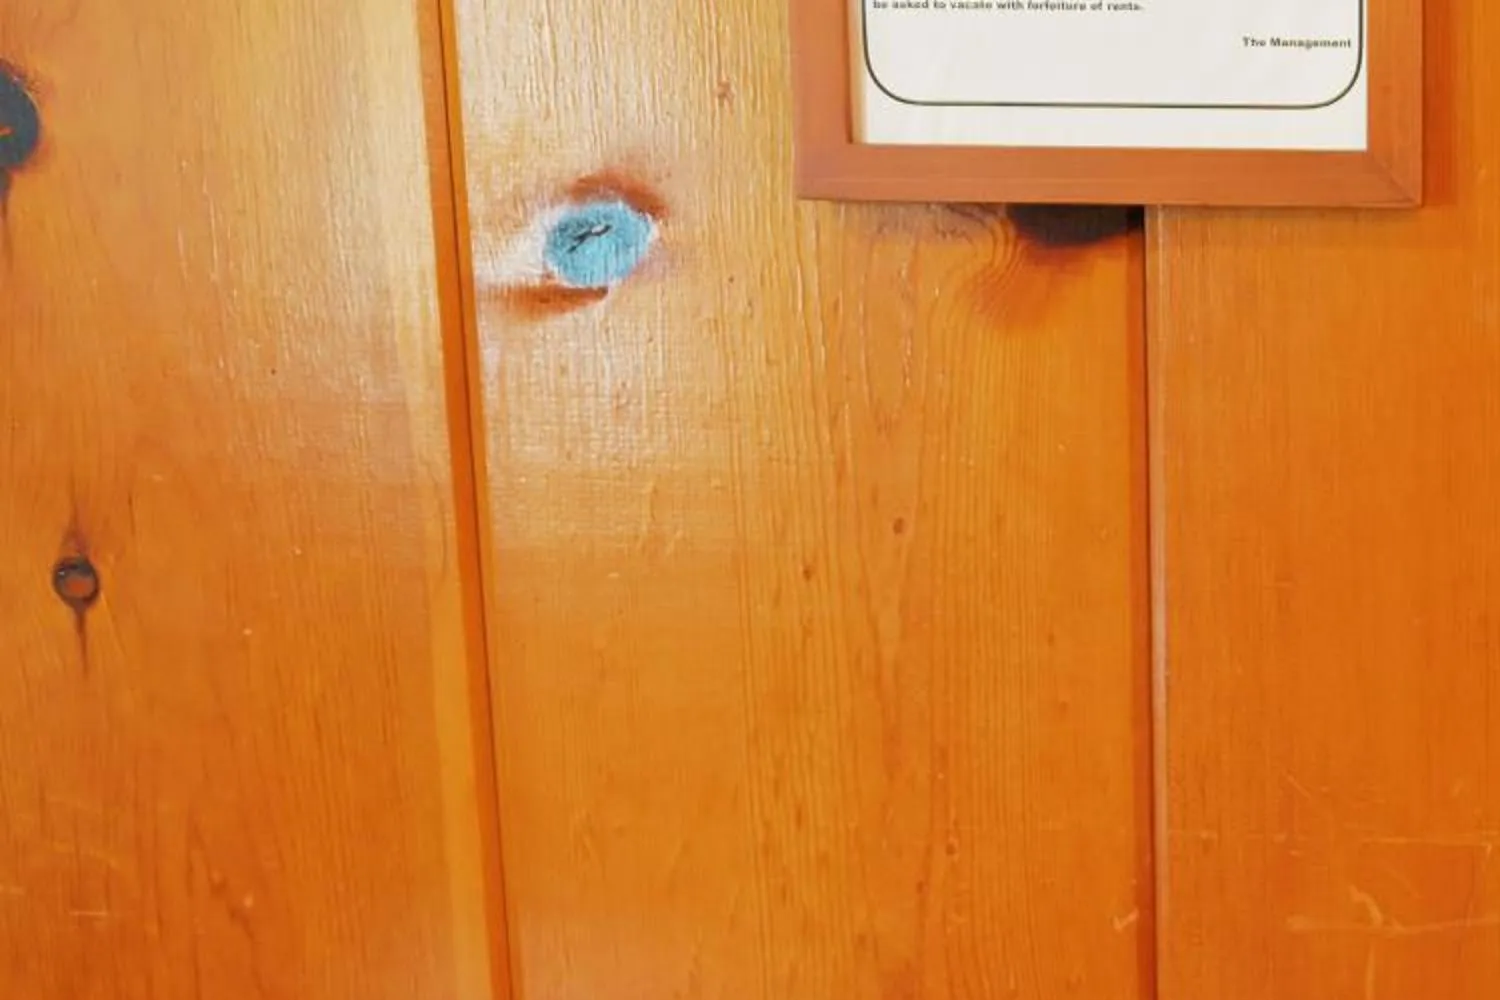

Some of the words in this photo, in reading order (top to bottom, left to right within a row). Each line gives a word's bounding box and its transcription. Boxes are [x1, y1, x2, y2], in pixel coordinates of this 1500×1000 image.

[933, 0, 947, 9] to
[997, 0, 1025, 10] with
[1242, 36, 1266, 48] The
[1269, 37, 1351, 50] Management
